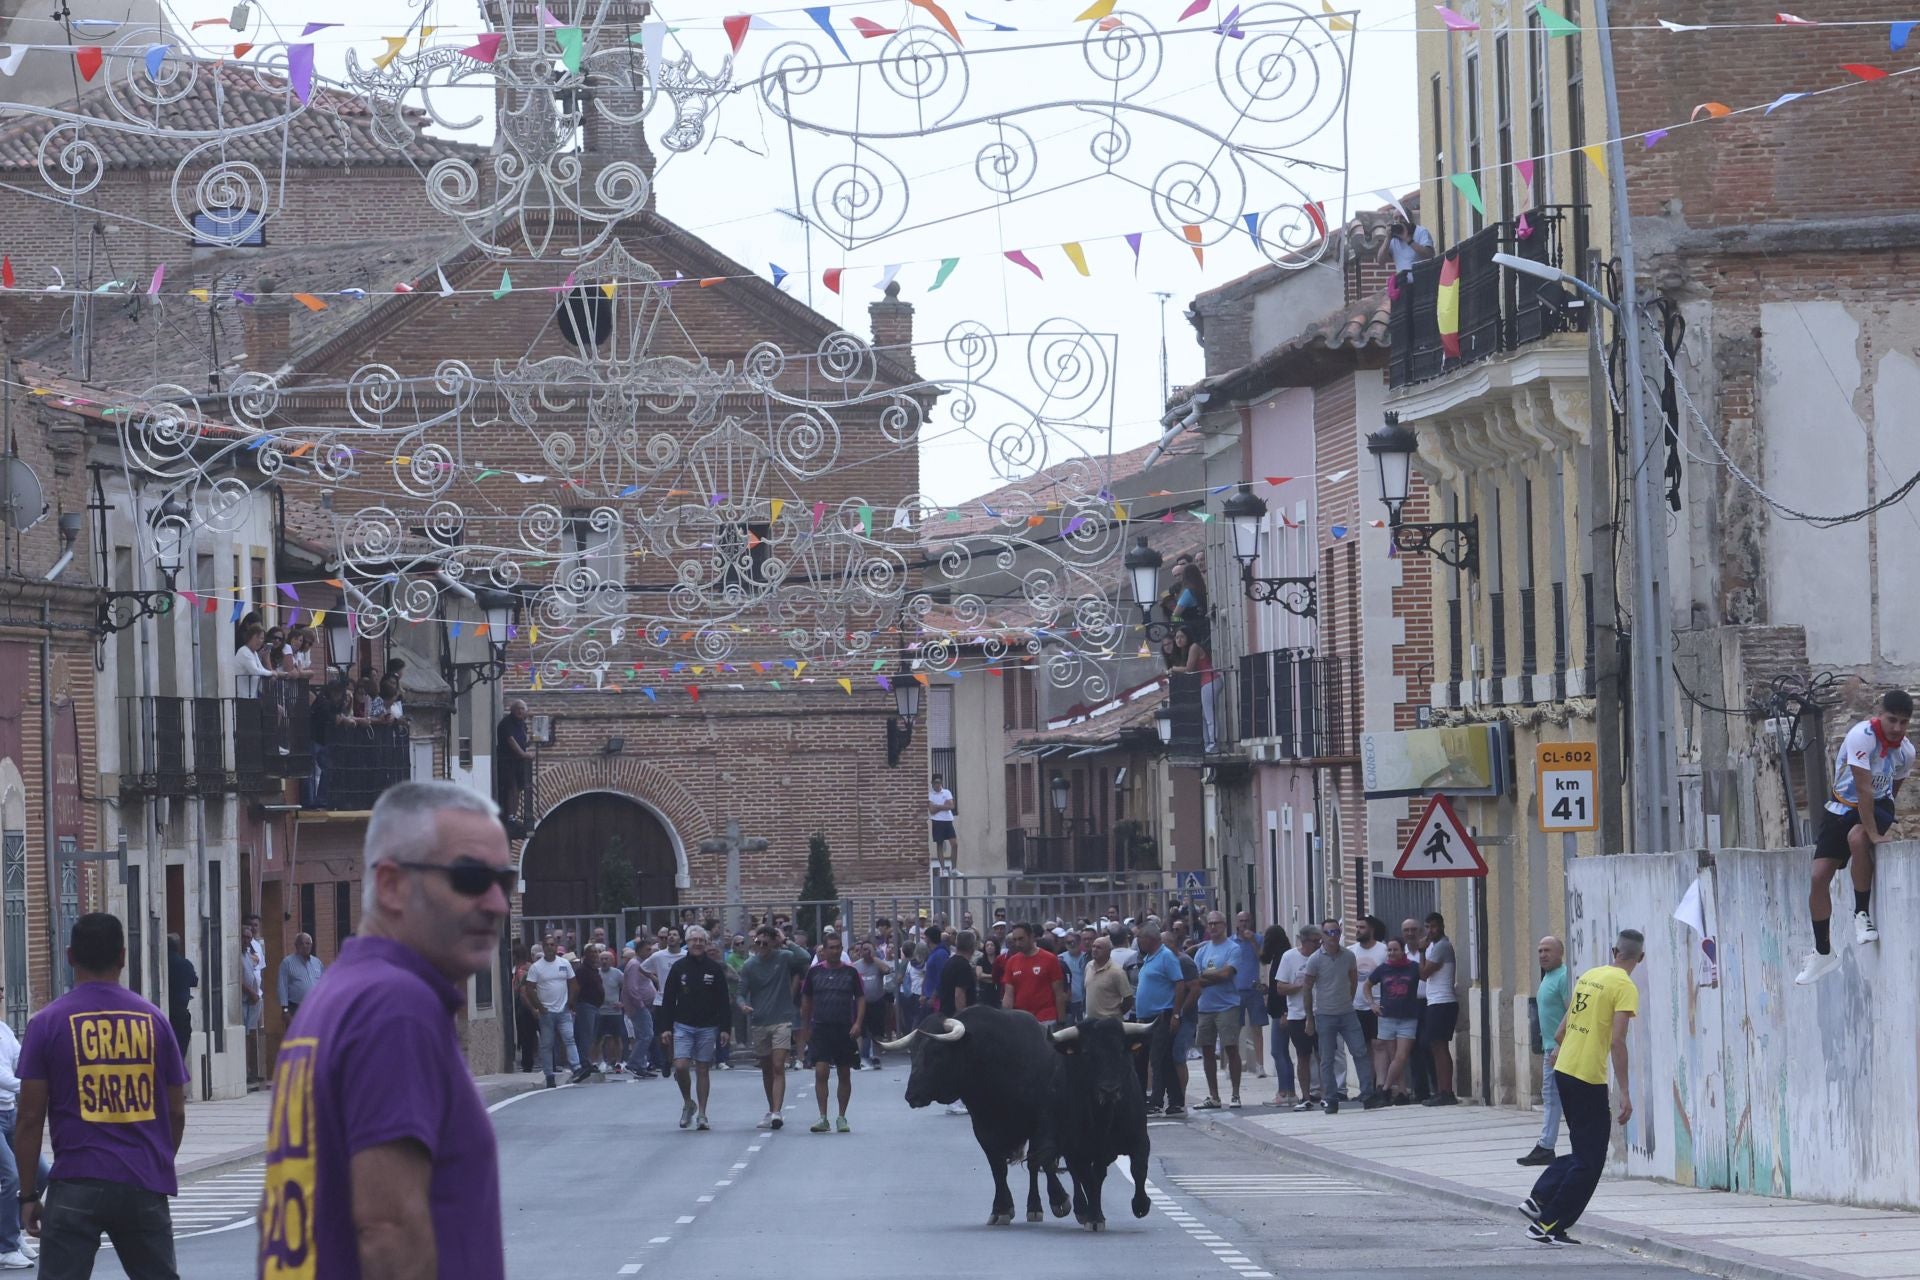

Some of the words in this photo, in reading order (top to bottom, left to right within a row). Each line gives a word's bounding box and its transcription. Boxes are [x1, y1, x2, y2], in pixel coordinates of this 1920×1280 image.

[1364, 735, 1378, 790] CORREOS
[1542, 751, 1592, 763] CL-602
[1555, 777, 1580, 791] km
[1551, 796, 1586, 820] 41
[80, 1018, 148, 1061] GRAN
[81, 1072, 152, 1113] SARAO
